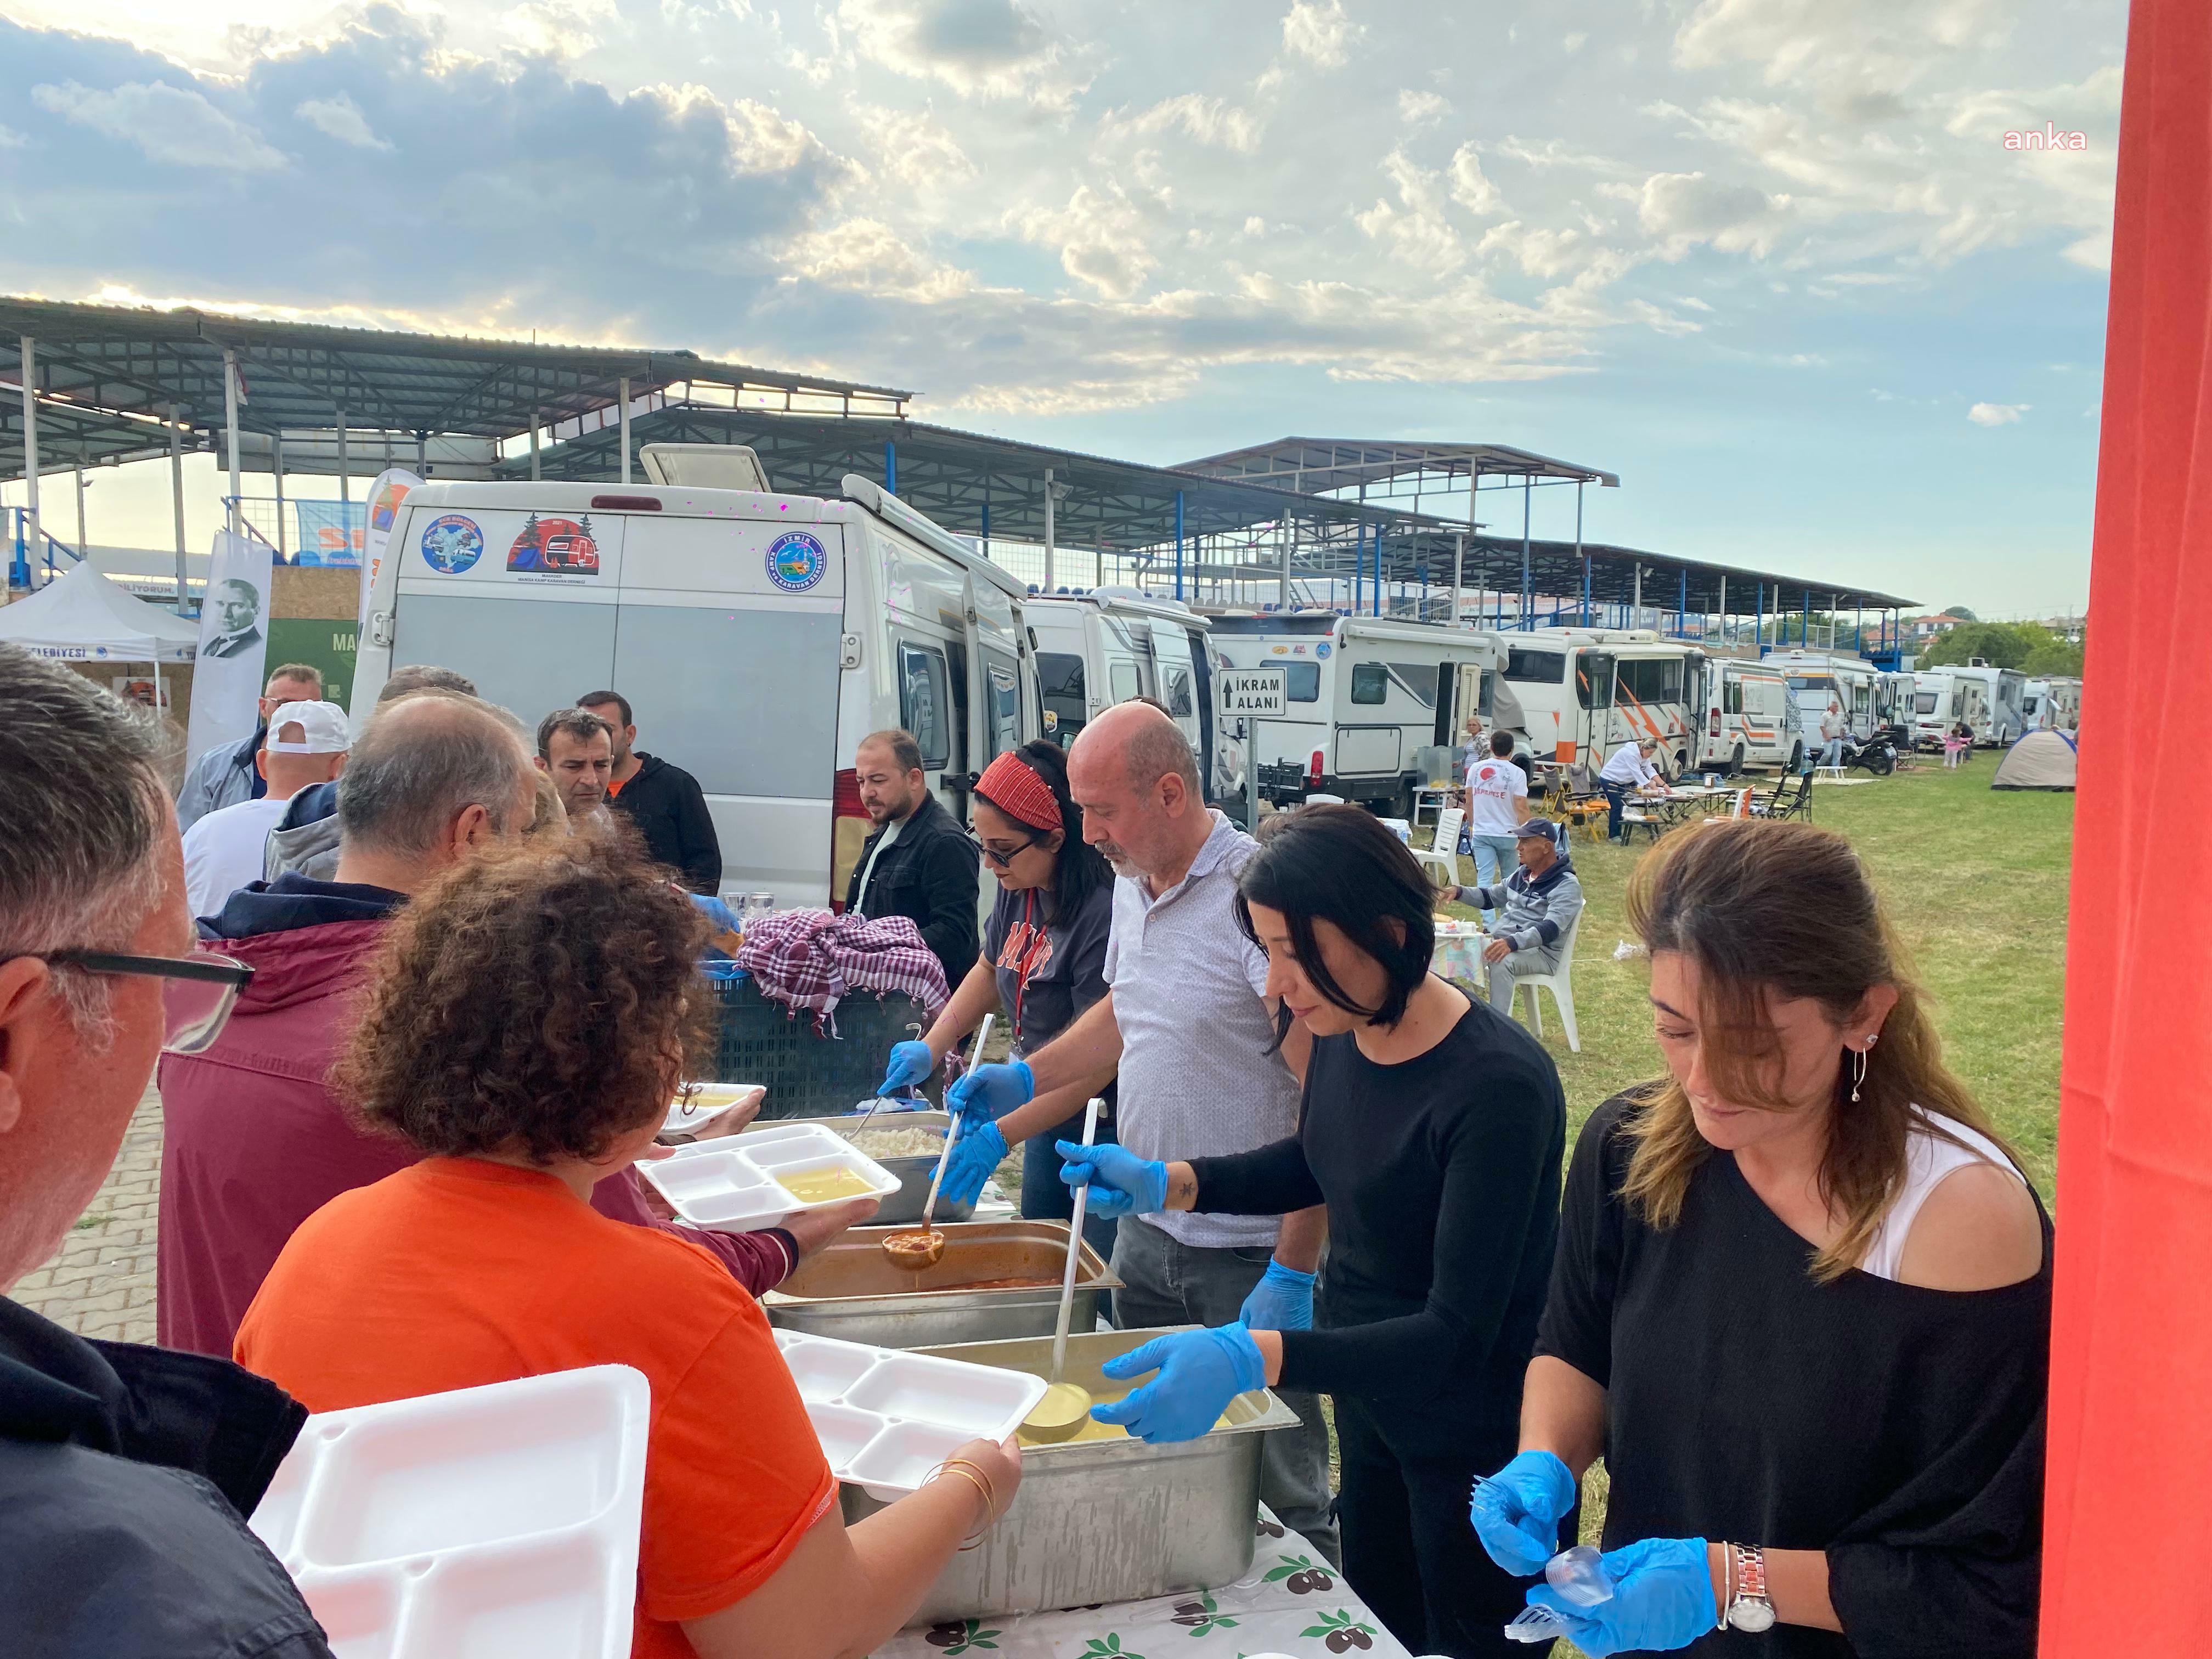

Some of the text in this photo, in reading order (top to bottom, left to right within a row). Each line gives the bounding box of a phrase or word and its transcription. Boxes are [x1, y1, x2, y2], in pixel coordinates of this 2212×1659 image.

[783, 535, 810, 544] İZMİR
[778, 579, 810, 589] KARAVAN
[1236, 676, 1279, 691] İKRAM
[1238, 697, 1278, 708] ALANI
